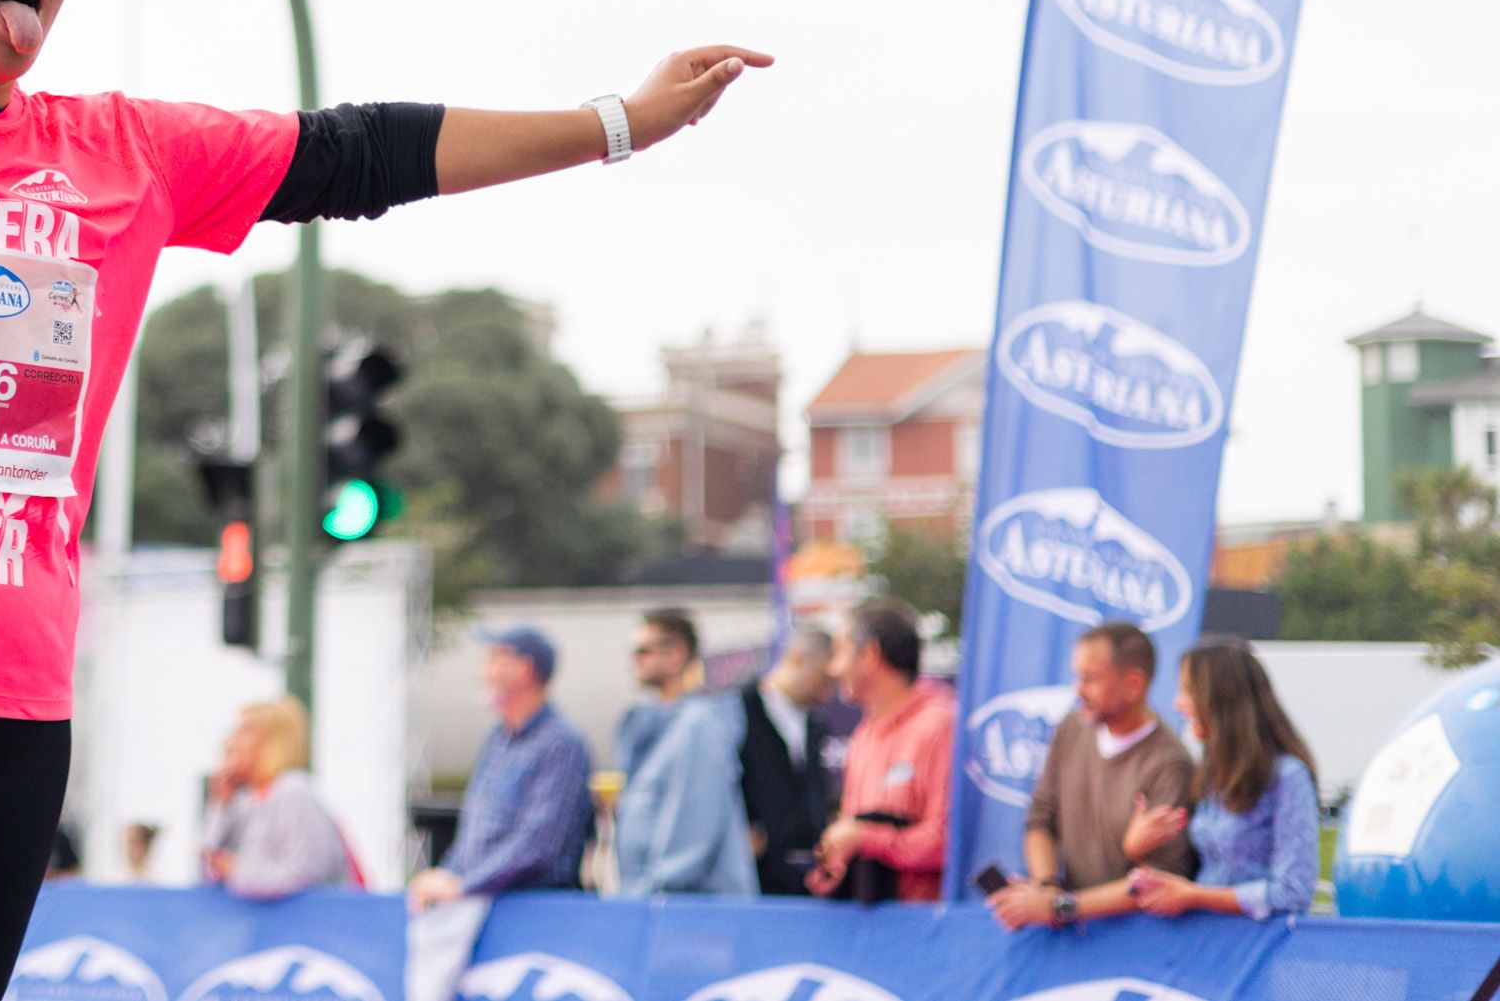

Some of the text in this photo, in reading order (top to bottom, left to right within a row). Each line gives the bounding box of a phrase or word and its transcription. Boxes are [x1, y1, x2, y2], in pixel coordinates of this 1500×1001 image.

[1022, 327, 1203, 429] ASTRIANA
[0, 434, 9, 446] A
[11, 434, 57, 451] CORUÑA
